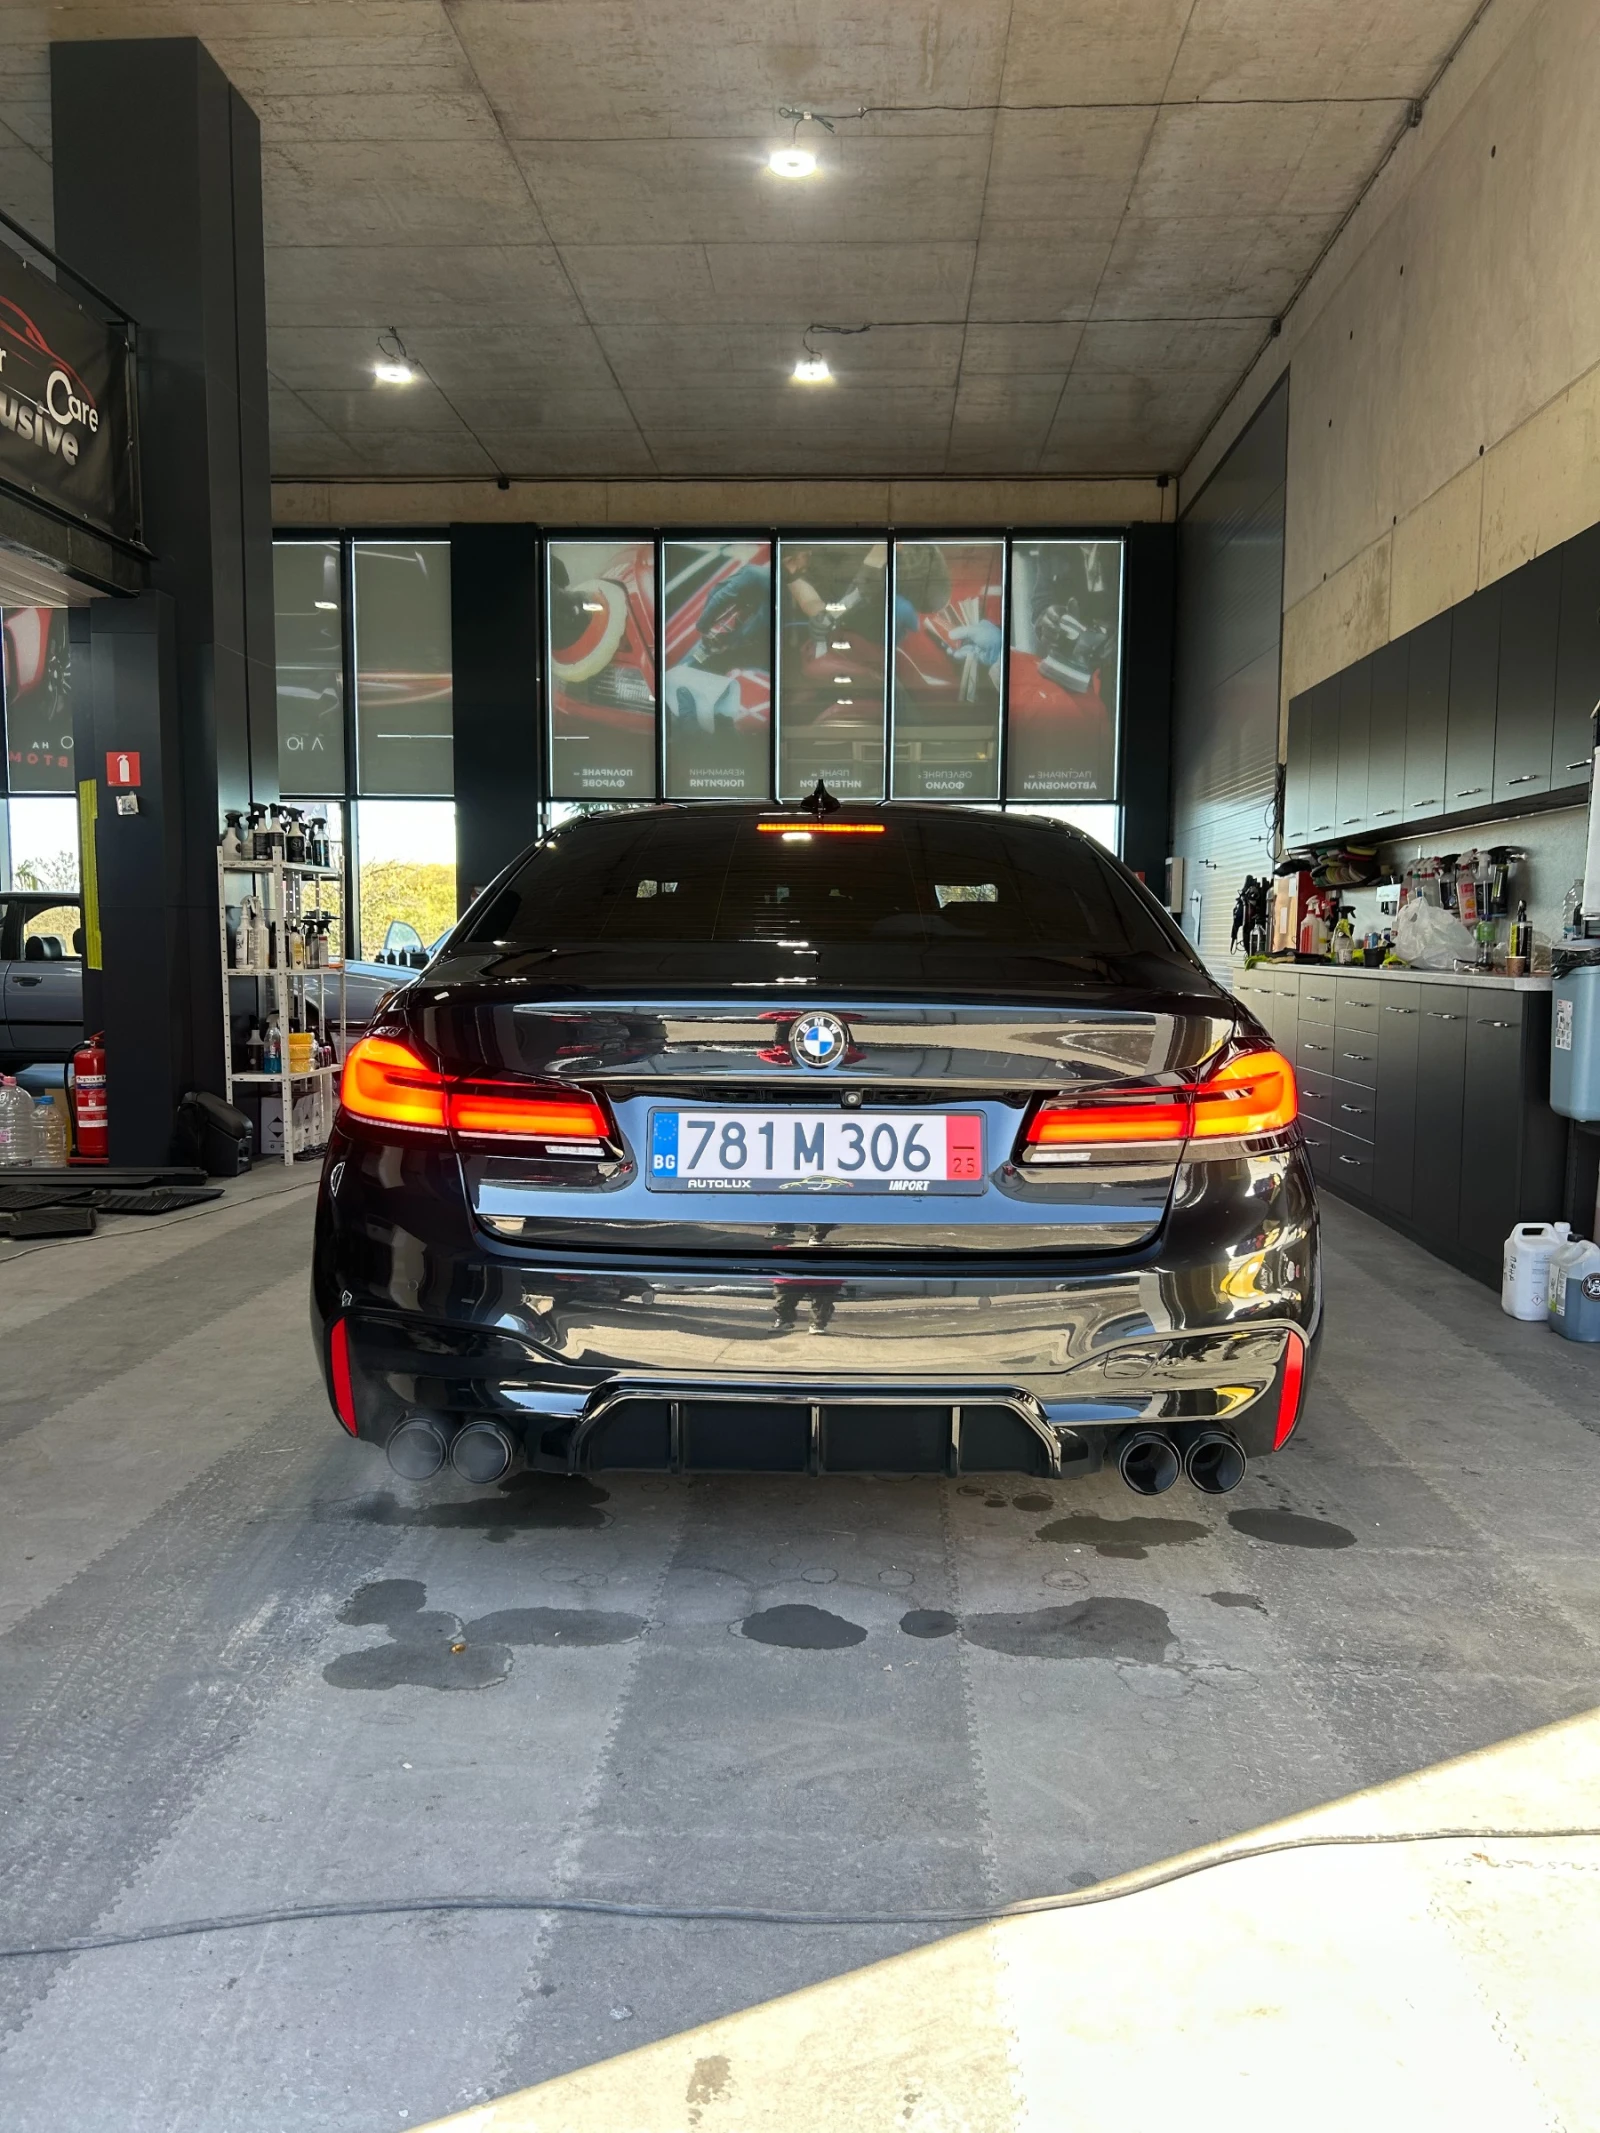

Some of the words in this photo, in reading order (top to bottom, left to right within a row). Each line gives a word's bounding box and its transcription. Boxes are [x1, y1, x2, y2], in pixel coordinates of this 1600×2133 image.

[46, 370, 99, 433] Care
[799, 1018, 841, 1035] BMW
[653, 1154, 676, 1171] BG
[688, 1179, 751, 1189] AUTOLUX
[888, 1180, 930, 1191] IMPORT
